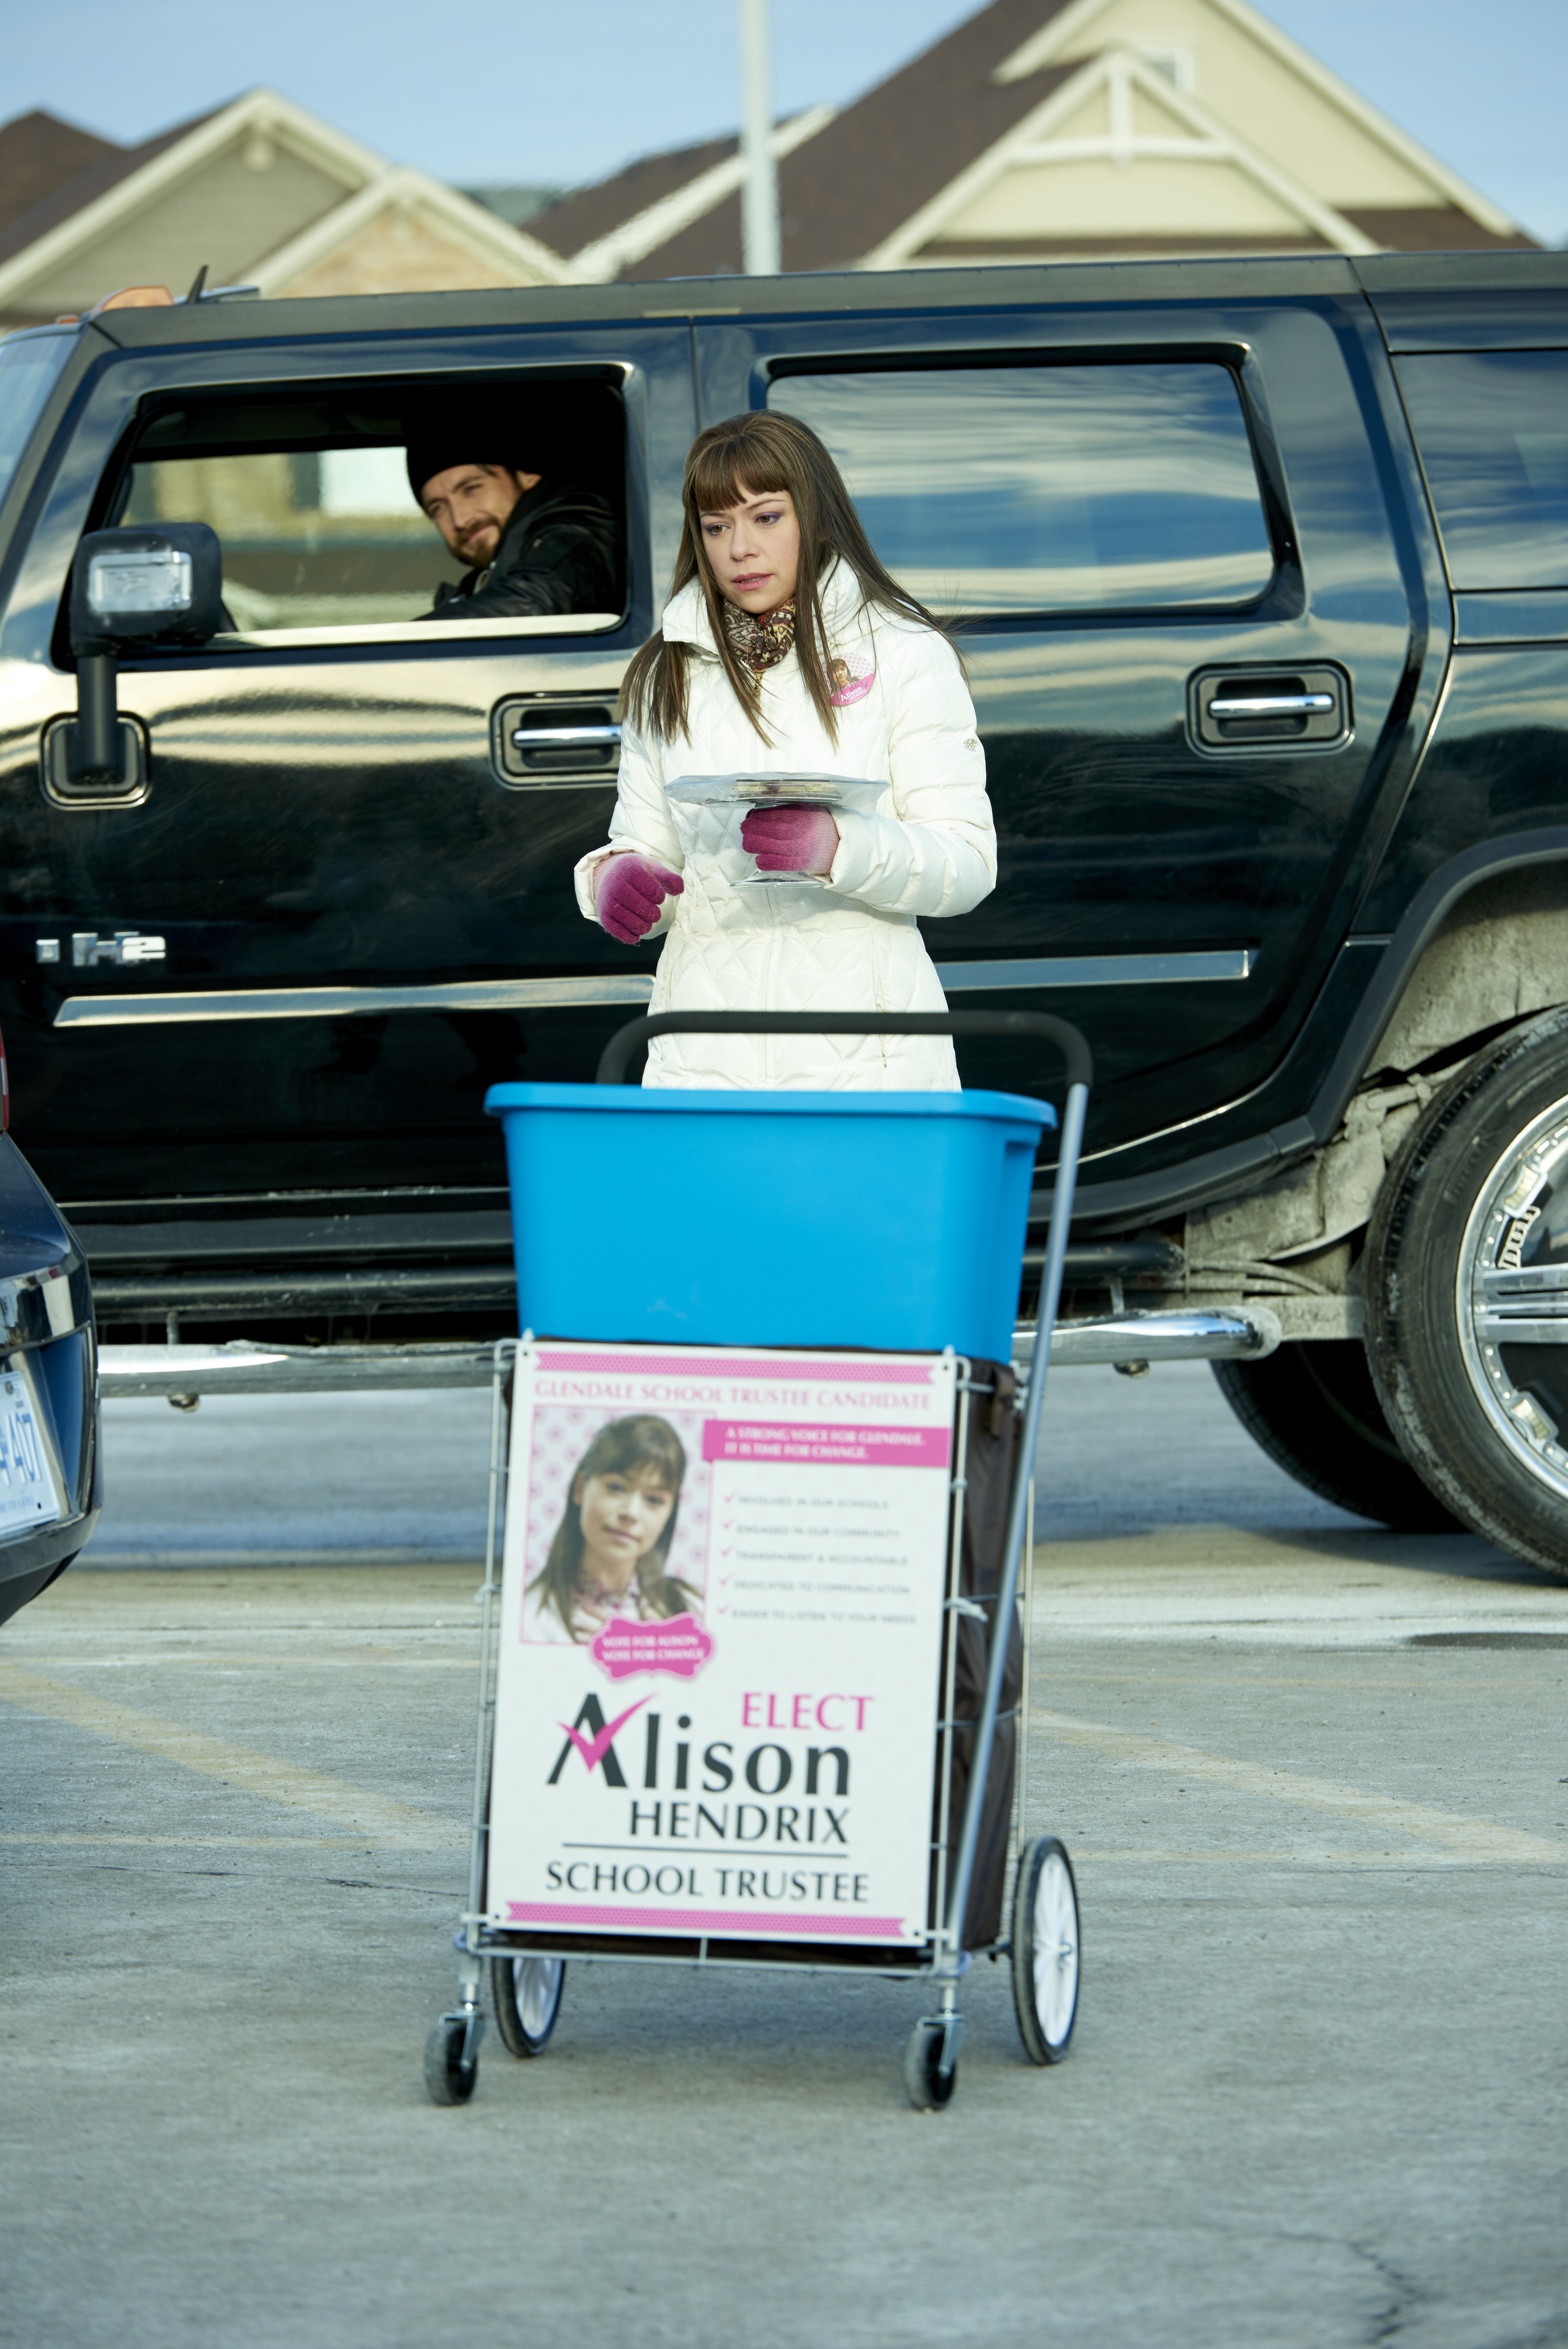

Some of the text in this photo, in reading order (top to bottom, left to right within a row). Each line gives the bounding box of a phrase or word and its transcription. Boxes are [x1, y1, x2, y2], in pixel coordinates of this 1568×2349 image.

[841, 687, 862, 702] Alison
[849, 689, 867, 701] HENDRIX
[534, 1380, 930, 1410] GLENDALE SCHOOL TRUSTEE CANDIDATE
[726, 1427, 737, 1438] A
[738, 1427, 790, 1442] STRONG
[790, 1429, 828, 1443] VOICE
[830, 1429, 856, 1444] FOR
[754, 1442, 782, 1457] TIME
[784, 1443, 810, 1458] FOR
[739, 1496, 888, 1509] INVOLVED IN OUR SCHOOLS
[737, 1524, 900, 1539] ENGAGED IN OUR COMMUNITY
[736, 1549, 814, 1563] TRANSPARENT
[829, 1553, 908, 1566] ACCOUNTABLE
[733, 1579, 910, 1595] DEDICATED TO COMMUNICATION
[732, 1608, 916, 1624] EAGER TO LISTEN TO YOUR NEEDS
[601, 1634, 699, 1649] VOTE FOR ALISON
[601, 1648, 704, 1662] VOTE FOR CHANGE
[742, 1692, 874, 1731] ELECT
[546, 1693, 850, 1796] Alison
[630, 1801, 850, 1844] HENDRIX
[546, 1860, 869, 1902] SCHOOL TRUSTEE
